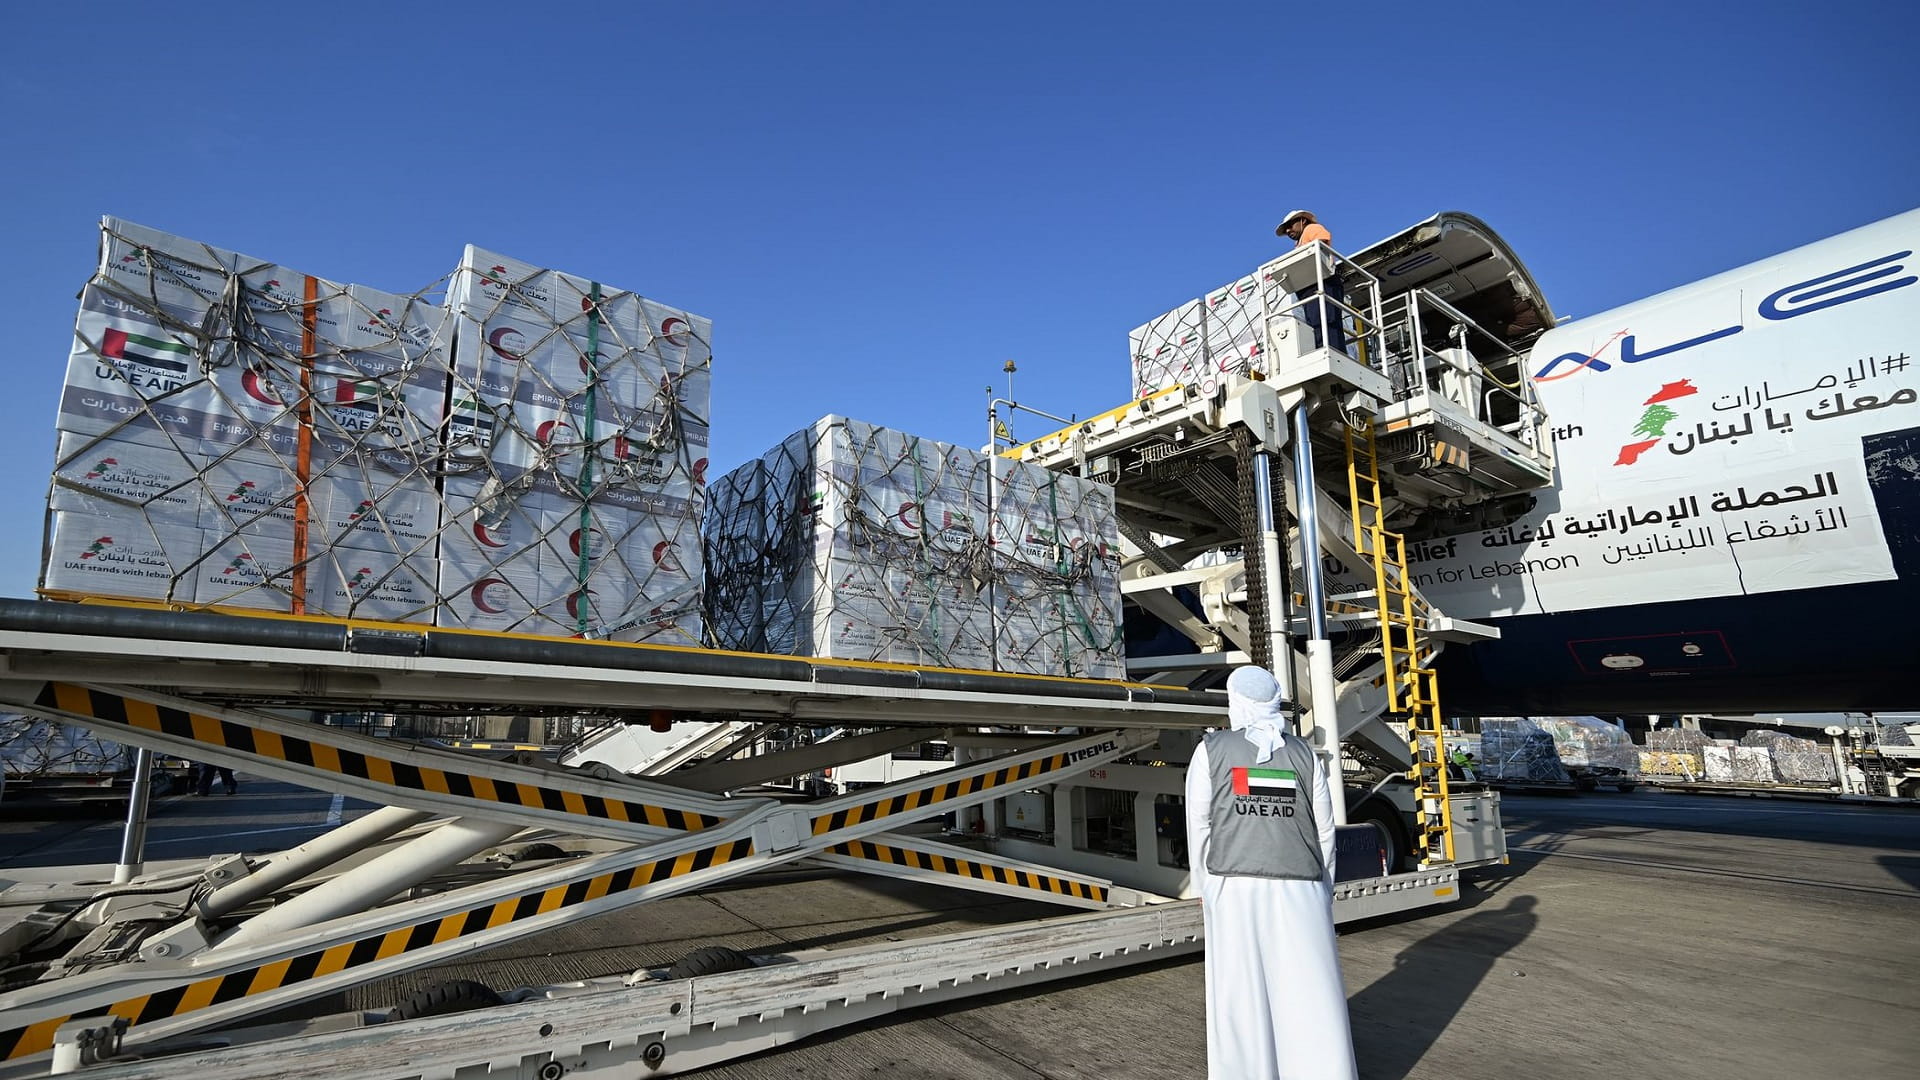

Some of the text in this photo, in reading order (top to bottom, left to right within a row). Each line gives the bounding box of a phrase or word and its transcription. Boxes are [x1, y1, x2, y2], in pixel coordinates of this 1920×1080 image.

[96, 366, 142, 386] UAE
[1668, 388, 1917, 455] معك يا لبنان
[1482, 471, 1839, 548] الحملة الإماراتية لإغاثة
[945, 535, 961, 545] UAE
[1602, 506, 1848, 565] الأشقاء اللبنانيين
[98, 553, 125, 562] لبنان
[1026, 548, 1041, 557] UAE
[64, 562, 86, 570] UAE
[88, 566, 120, 574] stands
[123, 569, 143, 577] with
[1436, 566, 1464, 582] for
[1469, 552, 1579, 581] Lebanon
[210, 577, 228, 585] UAE
[397, 597, 426, 605] lebanon
[1070, 740, 1118, 763] TREPEL
[1236, 804, 1295, 817] UAE AID
